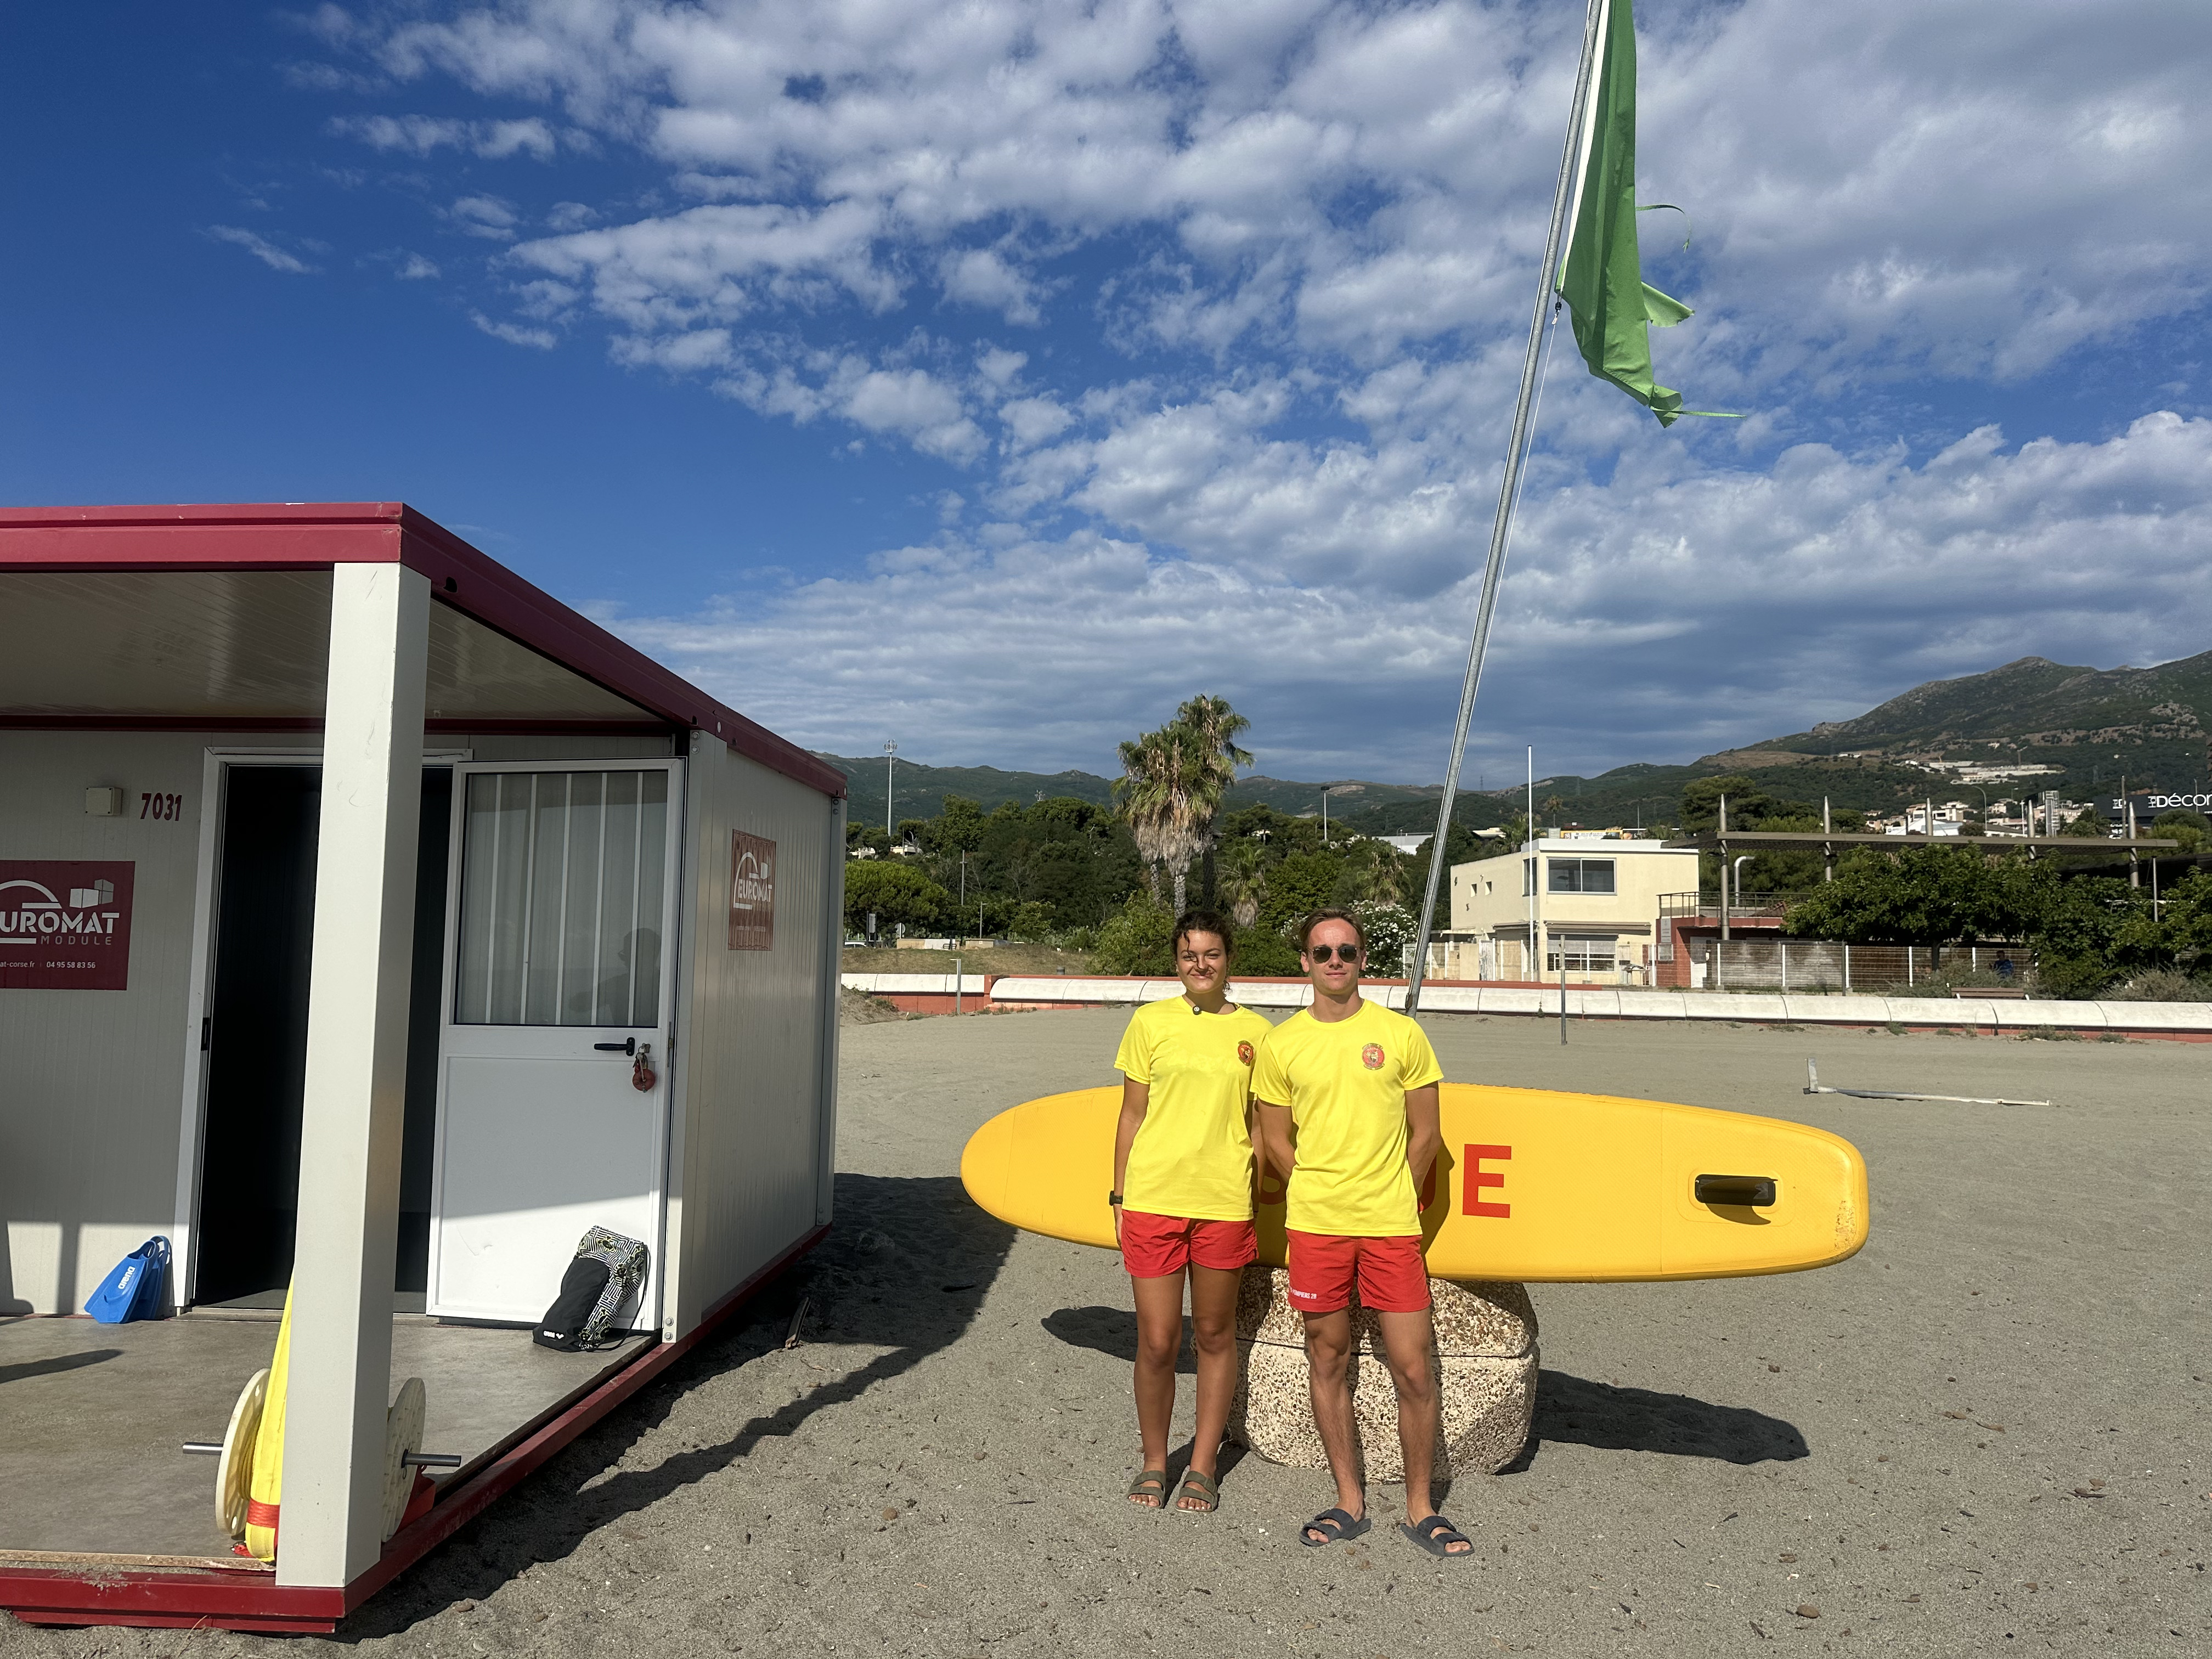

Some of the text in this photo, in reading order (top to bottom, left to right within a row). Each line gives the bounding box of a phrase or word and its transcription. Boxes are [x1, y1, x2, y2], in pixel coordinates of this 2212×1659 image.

[140, 792, 182, 821] 7031
[738, 878, 772, 902] EUROMAT
[41, 935, 112, 945] MODULE
[117, 1266, 136, 1290] arena
